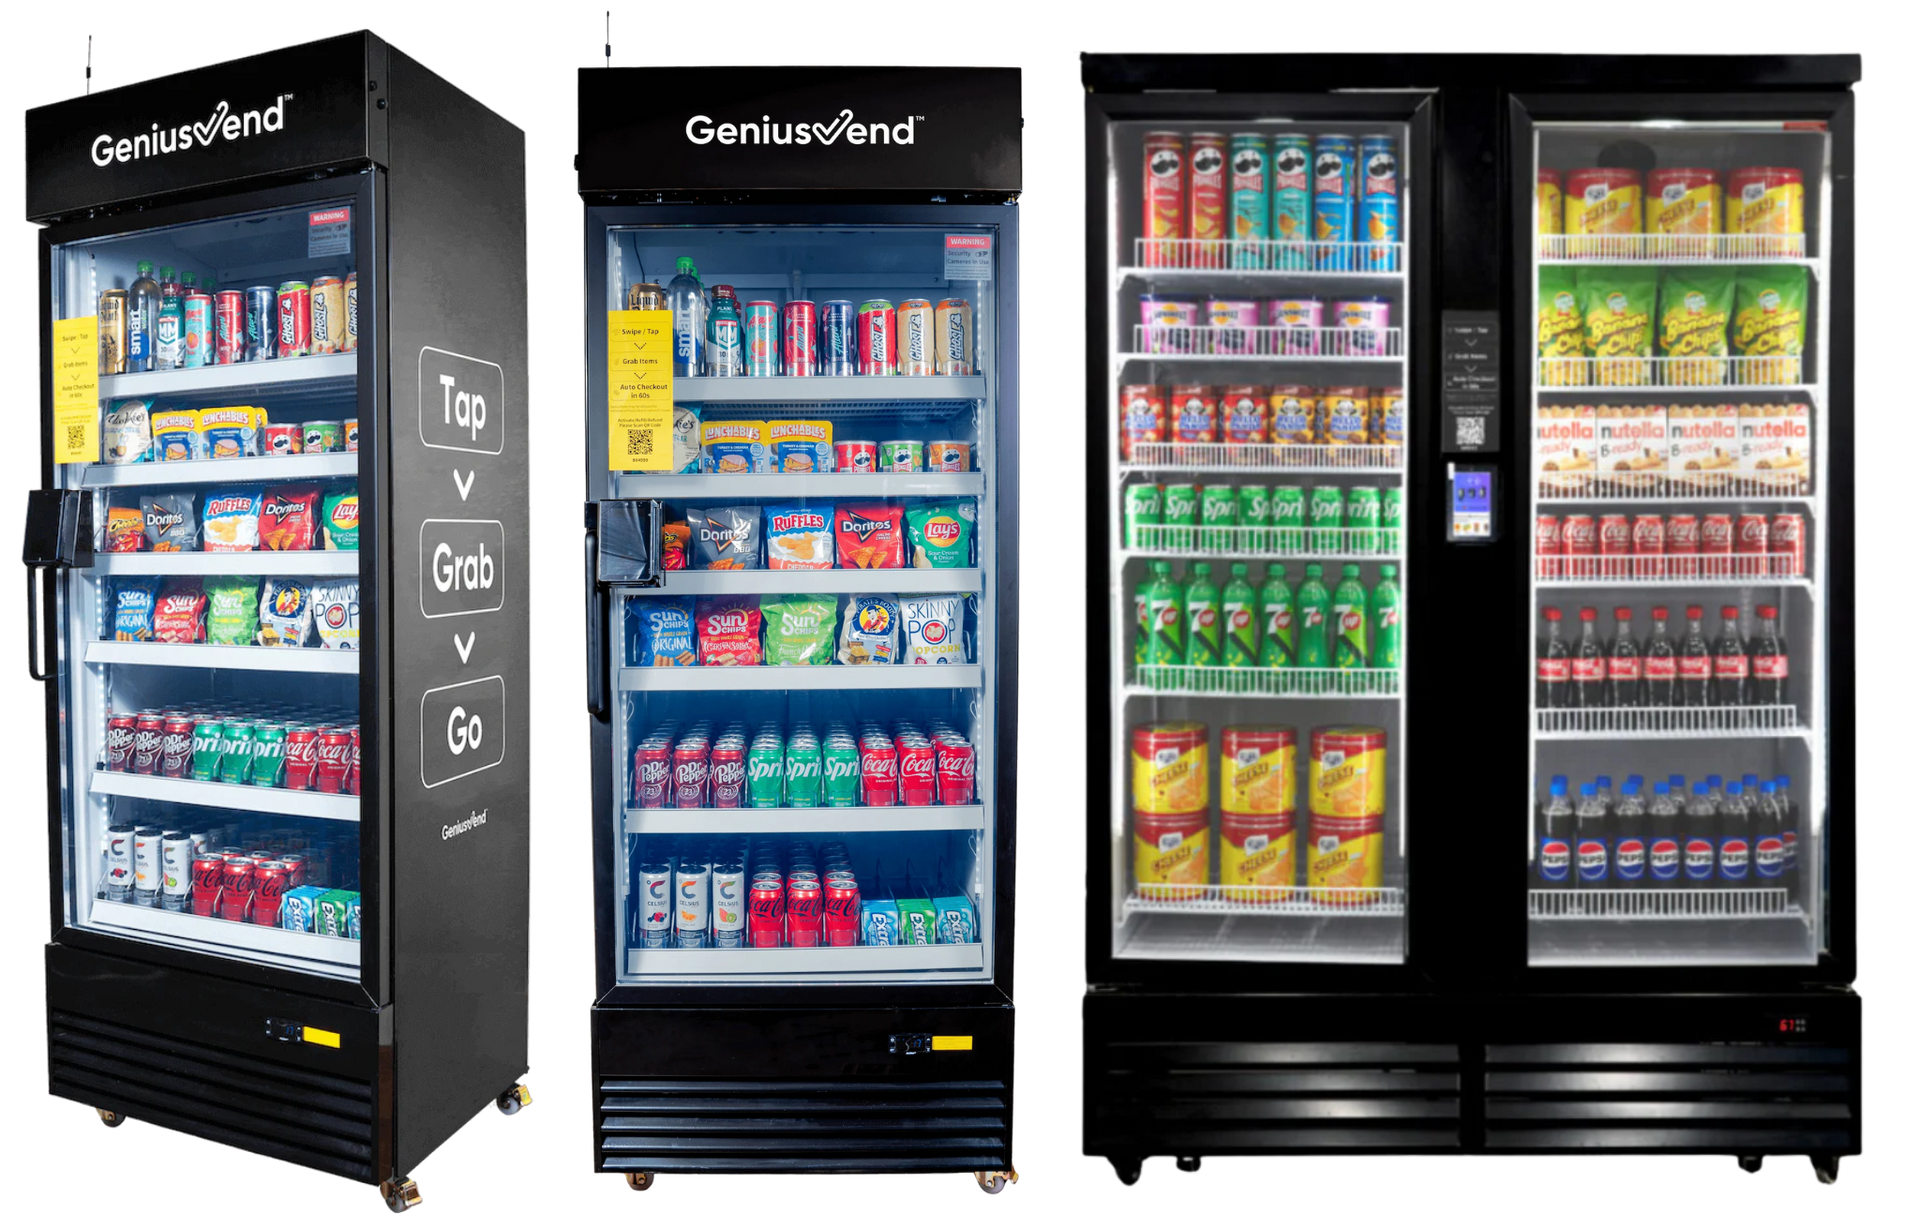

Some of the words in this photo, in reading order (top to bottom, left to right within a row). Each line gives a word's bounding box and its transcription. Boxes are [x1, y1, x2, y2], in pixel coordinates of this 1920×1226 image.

[313, 211, 344, 222] WARNING
[621, 328, 641, 336] Swipe
[1591, 312, 1648, 344] Banana
[1665, 311, 1725, 343] Banana
[439, 374, 487, 441] Tap
[155, 415, 195, 430] LUNCHABLES
[202, 410, 249, 426] LUNCHABLES
[704, 425, 761, 440] LUNCHABLES
[770, 424, 826, 440] LUNCHABLES
[1601, 420, 1664, 439] nutella
[1671, 420, 1736, 439] nutella
[1742, 419, 1806, 438] nutella
[207, 498, 251, 516] RUFFLES
[265, 502, 306, 515] Doritos
[335, 503, 358, 521] Lay
[146, 512, 183, 526] Doritos
[773, 514, 824, 532] RUFFLES
[843, 520, 891, 532] Doritos
[700, 527, 750, 541] Doritos
[926, 522, 959, 540] Lay's
[432, 542, 494, 592] Grab
[117, 590, 148, 609] Sun
[319, 584, 359, 603] SKINNY
[163, 595, 197, 614] Sun
[908, 600, 960, 620] SKINNY
[650, 611, 687, 632] Sun
[664, 621, 689, 629] CHIPS
[708, 614, 747, 635] Sun
[781, 612, 822, 636] Sun
[908, 618, 956, 646] POP
[651, 640, 694, 655] ORIGINAL
[446, 705, 482, 756] Go
[638, 765, 670, 783] Pepper
[650, 761, 665, 773] Dr
[675, 765, 708, 783] Pepper
[687, 761, 702, 773] Dr
[714, 765, 746, 783] Pepper
[725, 761, 741, 773] Dr
[748, 756, 784, 781] Spri
[786, 756, 821, 781] Spri
[824, 756, 860, 781] Spri
